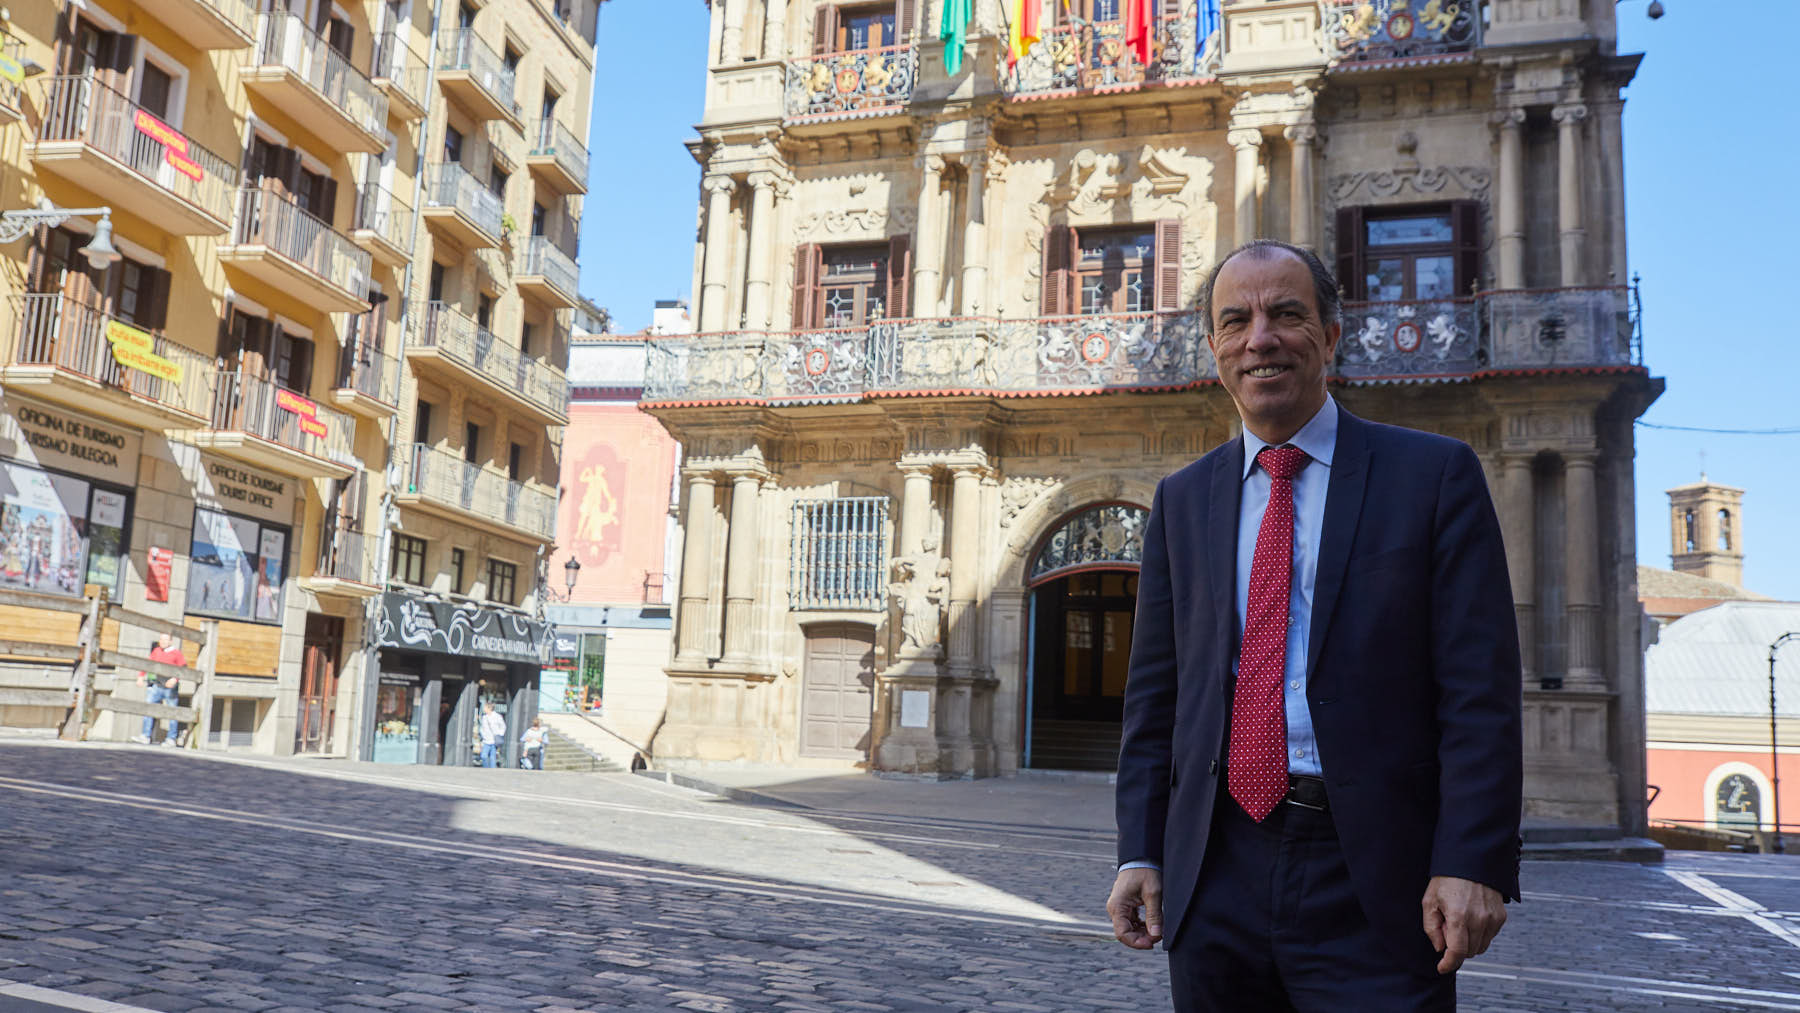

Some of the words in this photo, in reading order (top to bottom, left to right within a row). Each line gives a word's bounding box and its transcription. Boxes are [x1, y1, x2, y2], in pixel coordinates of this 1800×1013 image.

[18, 406, 64, 433] OFICINA
[66, 419, 81, 438] DE
[83, 425, 126, 449] TURISMO
[22, 428, 68, 454] TURISMO
[70, 442, 118, 468] BULEGOA
[210, 462, 237, 482] OFFICE
[238, 470, 249, 485] DE
